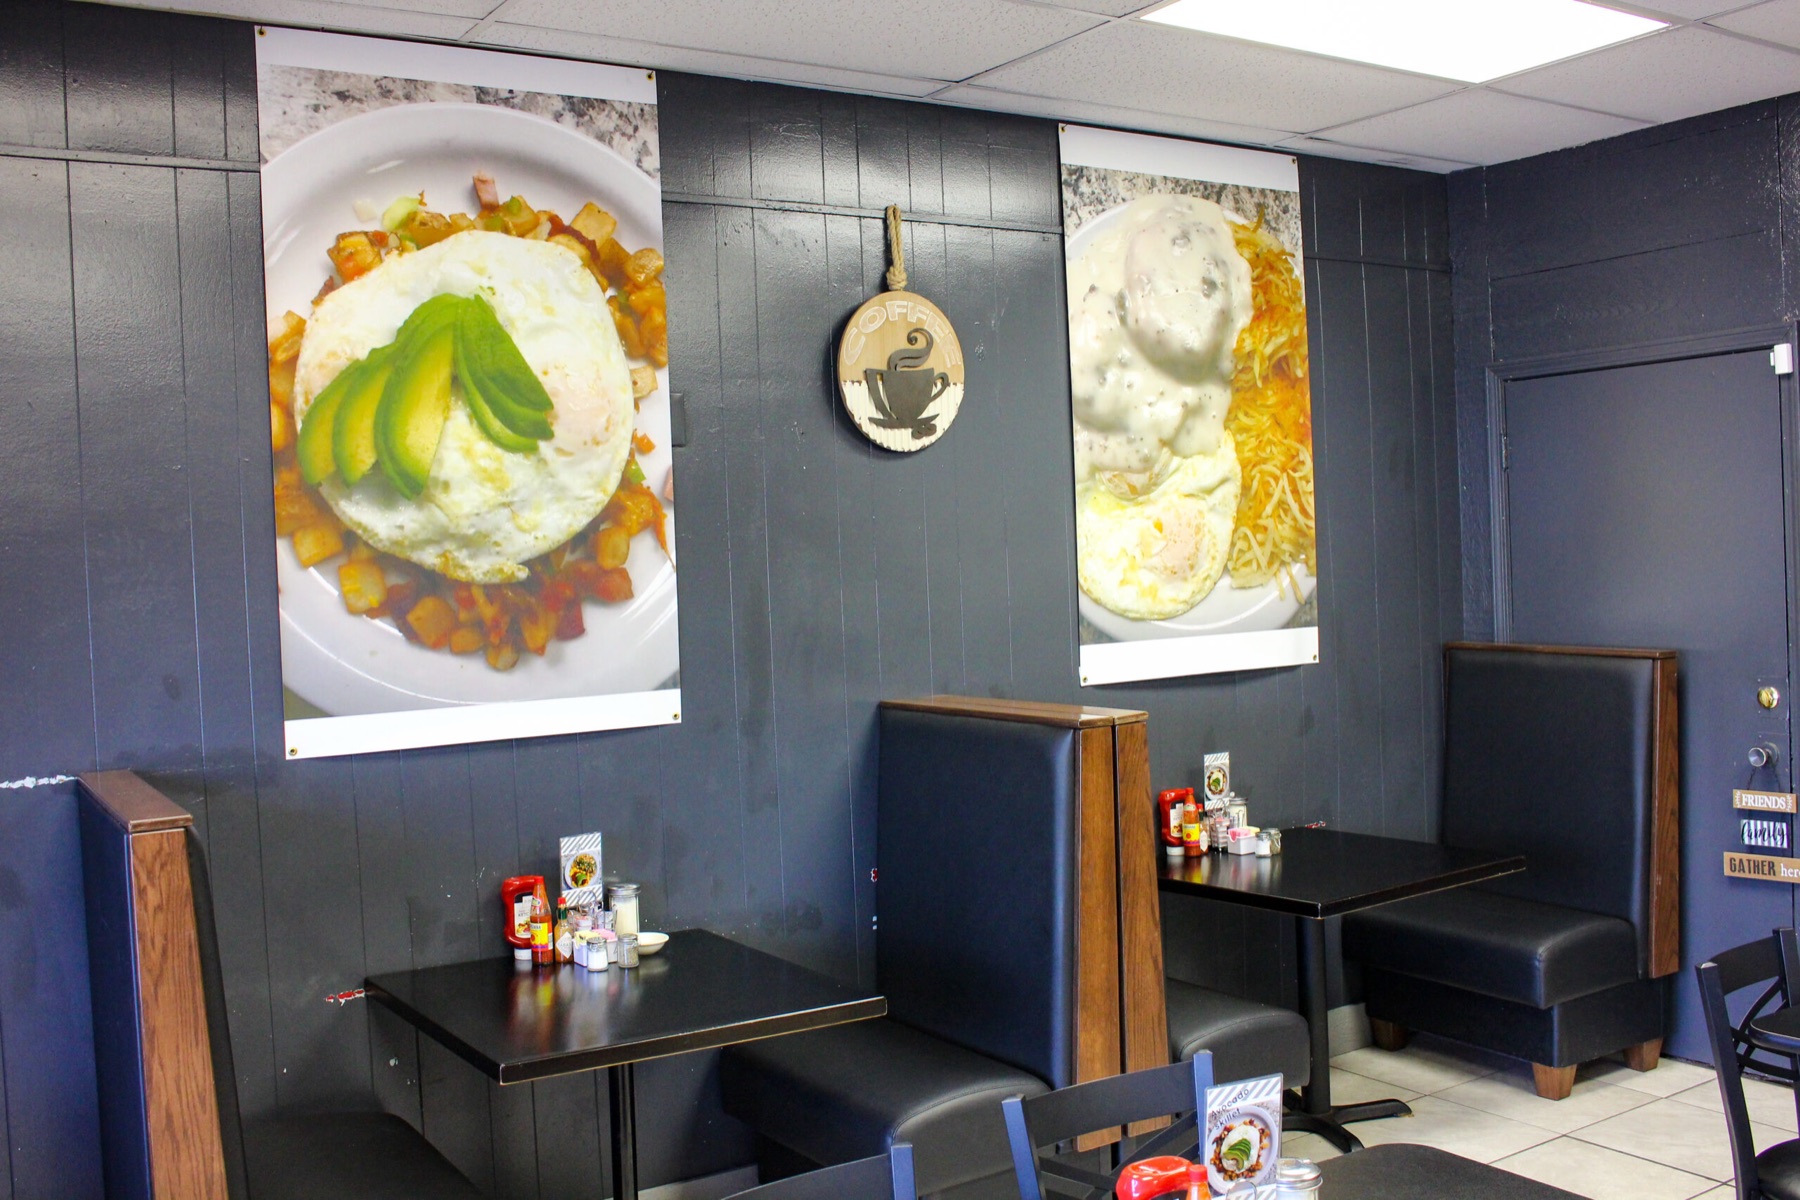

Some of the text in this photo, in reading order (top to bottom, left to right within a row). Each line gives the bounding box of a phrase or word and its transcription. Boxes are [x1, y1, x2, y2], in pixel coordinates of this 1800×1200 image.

[843, 301, 961, 367] COFFEE
[1742, 794, 1786, 809] FRIENDS
[1730, 857, 1776, 876] GATHER
[1211, 1088, 1249, 1118] Avocado
[1215, 1108, 1241, 1129] skillet
